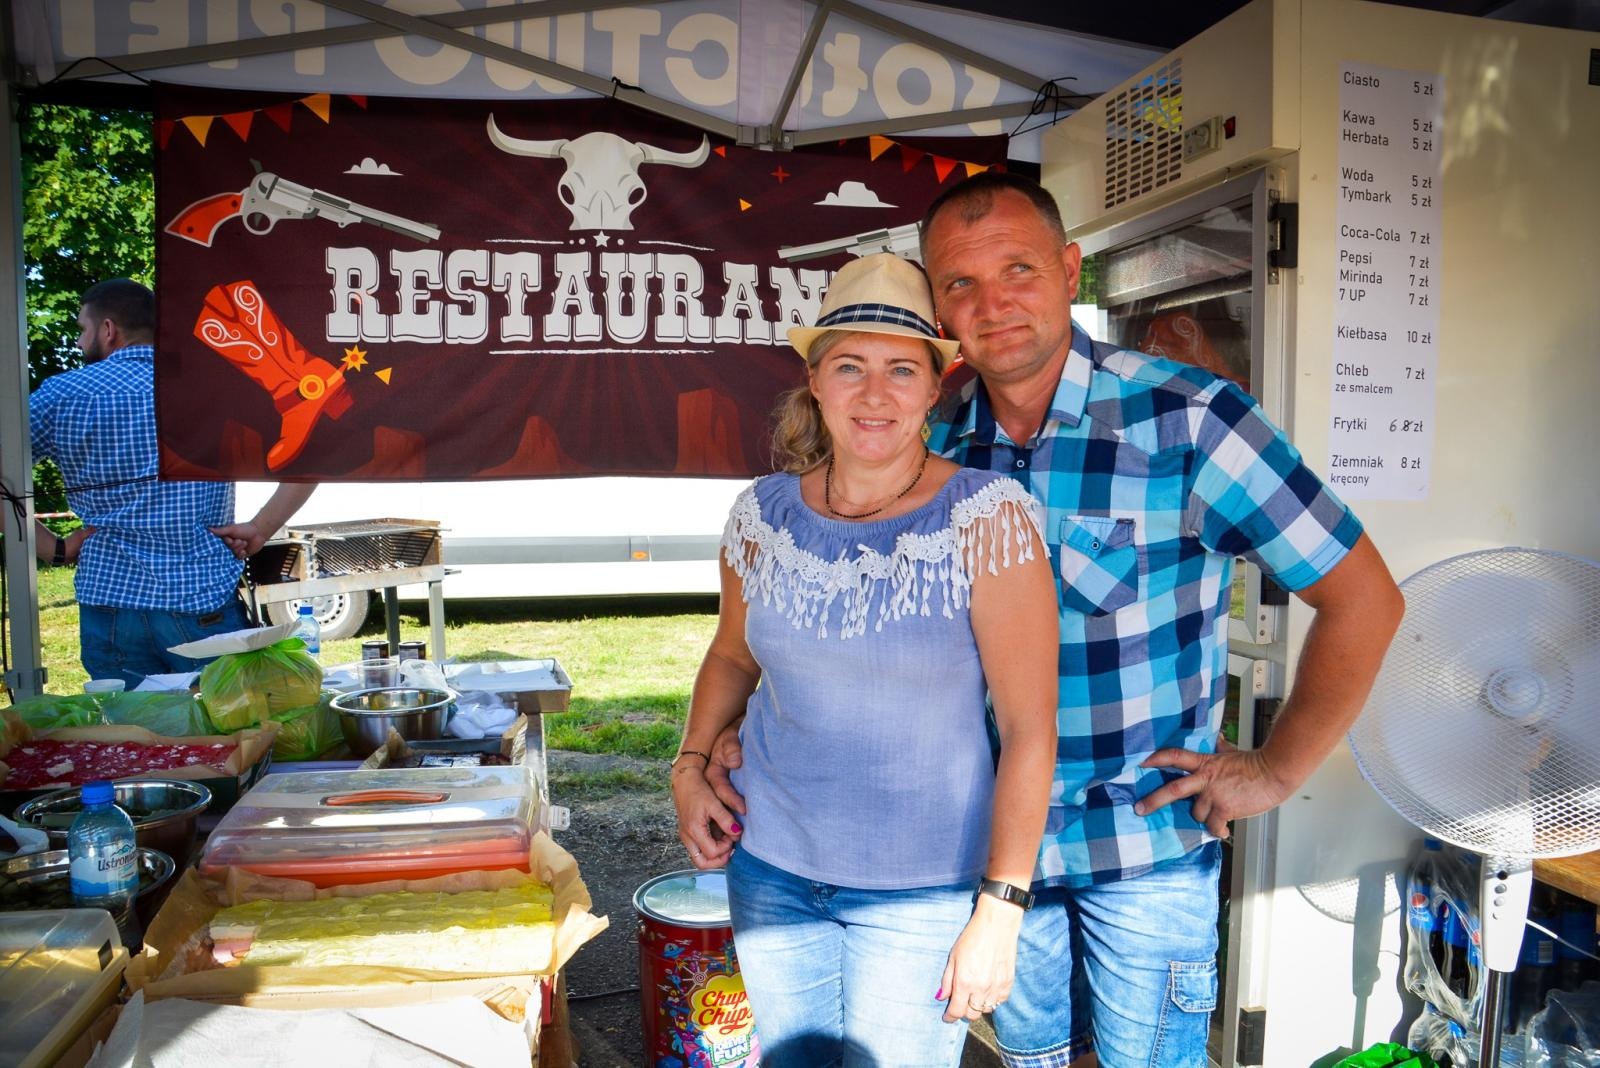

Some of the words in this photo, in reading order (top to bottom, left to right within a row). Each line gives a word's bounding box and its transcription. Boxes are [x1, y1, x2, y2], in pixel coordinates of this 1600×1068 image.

[1344, 72, 1379, 88] Ciasto
[1414, 82, 1419, 93] 5
[1424, 84, 1433, 95] zł
[1343, 110, 1375, 125] Kawa
[1413, 119, 1418, 131] 5
[1423, 122, 1432, 132] zł
[1343, 129, 1389, 146] Herbata
[1413, 138, 1418, 149] 5
[1423, 140, 1432, 151] zł
[1342, 167, 1374, 182] Woda
[1412, 175, 1418, 187] 5
[1422, 177, 1432, 188] zł
[1342, 187, 1391, 203] Tymbark
[1411, 194, 1417, 206] 5
[1422, 196, 1431, 207] zł
[1341, 225, 1400, 241] Coca-Cola
[1411, 232, 1416, 243] 7
[1420, 233, 1430, 244] zł
[1341, 251, 1372, 266] Pepsi
[1410, 256, 1415, 267] 7
[1420, 258, 1429, 269] zł
[1340, 270, 1383, 284] Mirinda
[1409, 275, 1415, 286] 7
[1419, 276, 1429, 287] zł
[325, 247, 839, 346] RESTAURAN
[1339, 288, 1345, 300] 7
[1350, 290, 1365, 301] UP
[1409, 293, 1415, 305] 7
[1419, 295, 1428, 305] zł
[1337, 326, 1387, 341] Kiełbasa
[1407, 331, 1417, 343] 10
[1422, 333, 1431, 344] zł
[1336, 364, 1369, 376] Chleb
[1406, 367, 1411, 379] 7
[1415, 368, 1424, 380] zł
[1335, 384, 1346, 392] ze
[1349, 383, 1392, 394] smalcem
[1334, 417, 1367, 432] Frytki
[1413, 420, 1423, 433] zł
[1332, 455, 1383, 468] Ziemniak
[1401, 457, 1407, 469] 8
[1411, 458, 1420, 469] zł
[1330, 474, 1369, 486] kręcony
